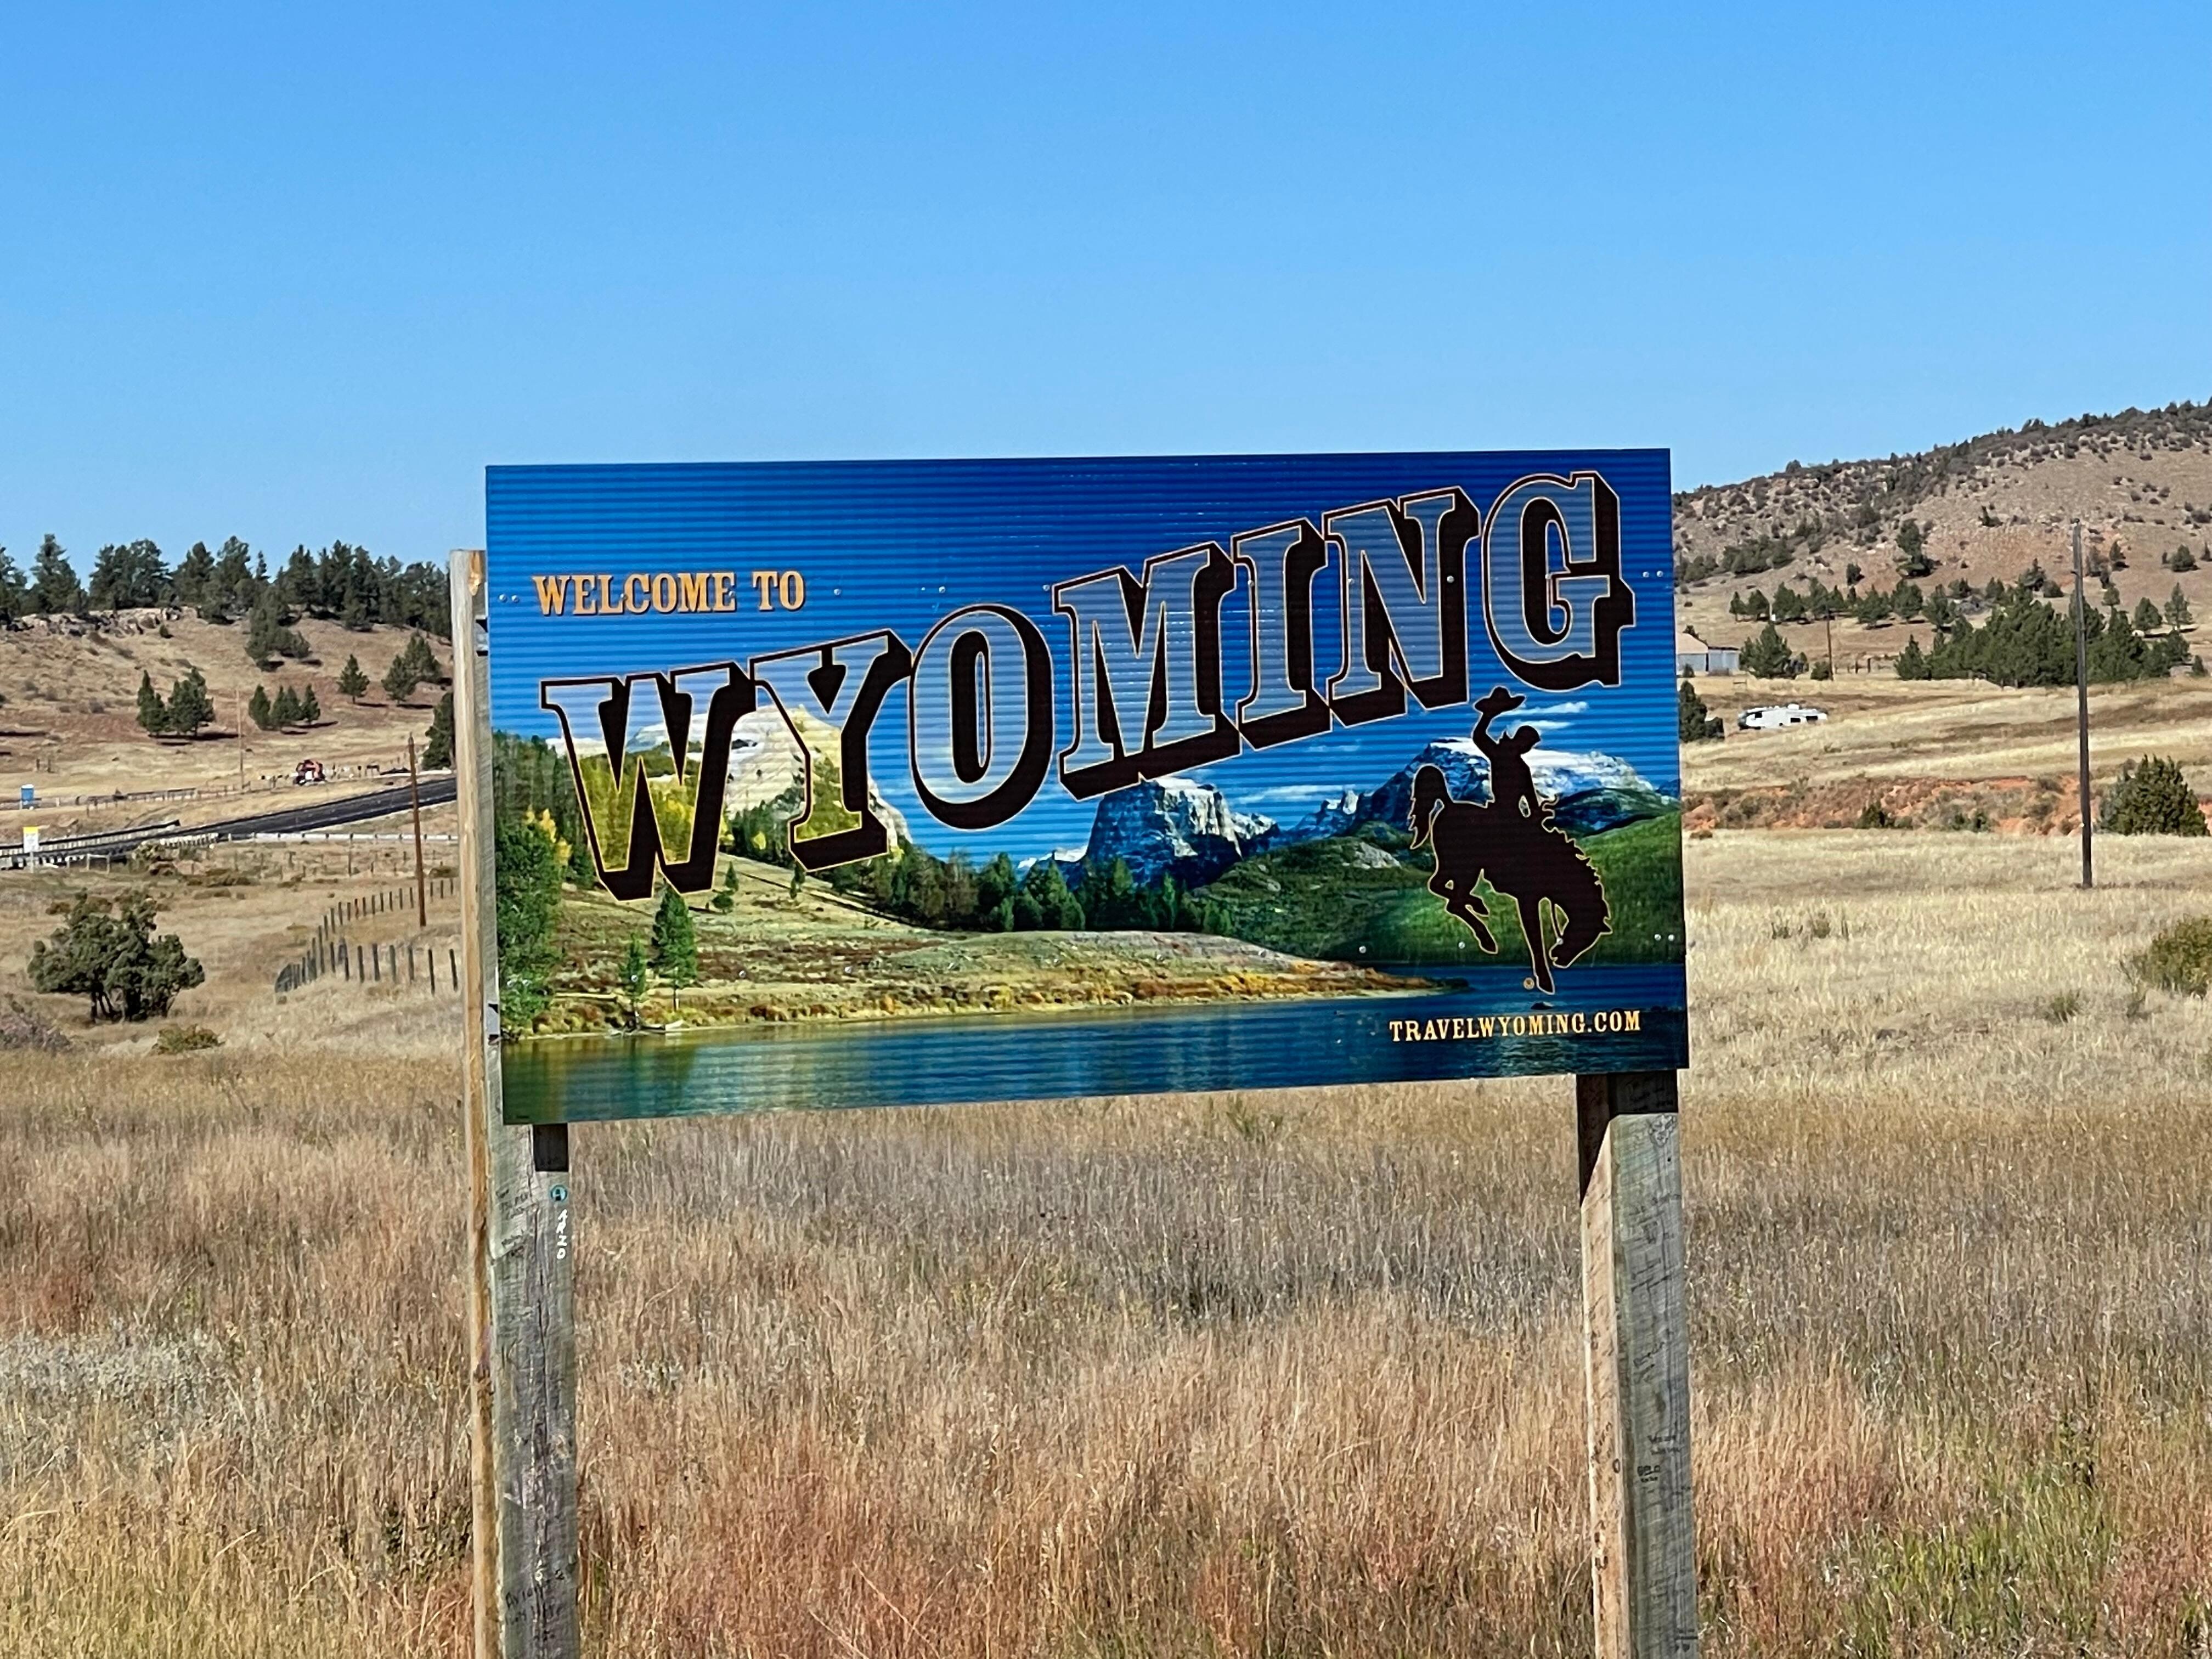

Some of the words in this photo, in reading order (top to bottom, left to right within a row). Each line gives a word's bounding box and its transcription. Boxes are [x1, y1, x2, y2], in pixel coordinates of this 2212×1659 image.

[532, 572, 736, 615] WELCOME
[752, 571, 805, 611] TO
[542, 471, 1634, 899] WYOMING
[1389, 1010, 1641, 1042] TRAVELWYOMING.COM
